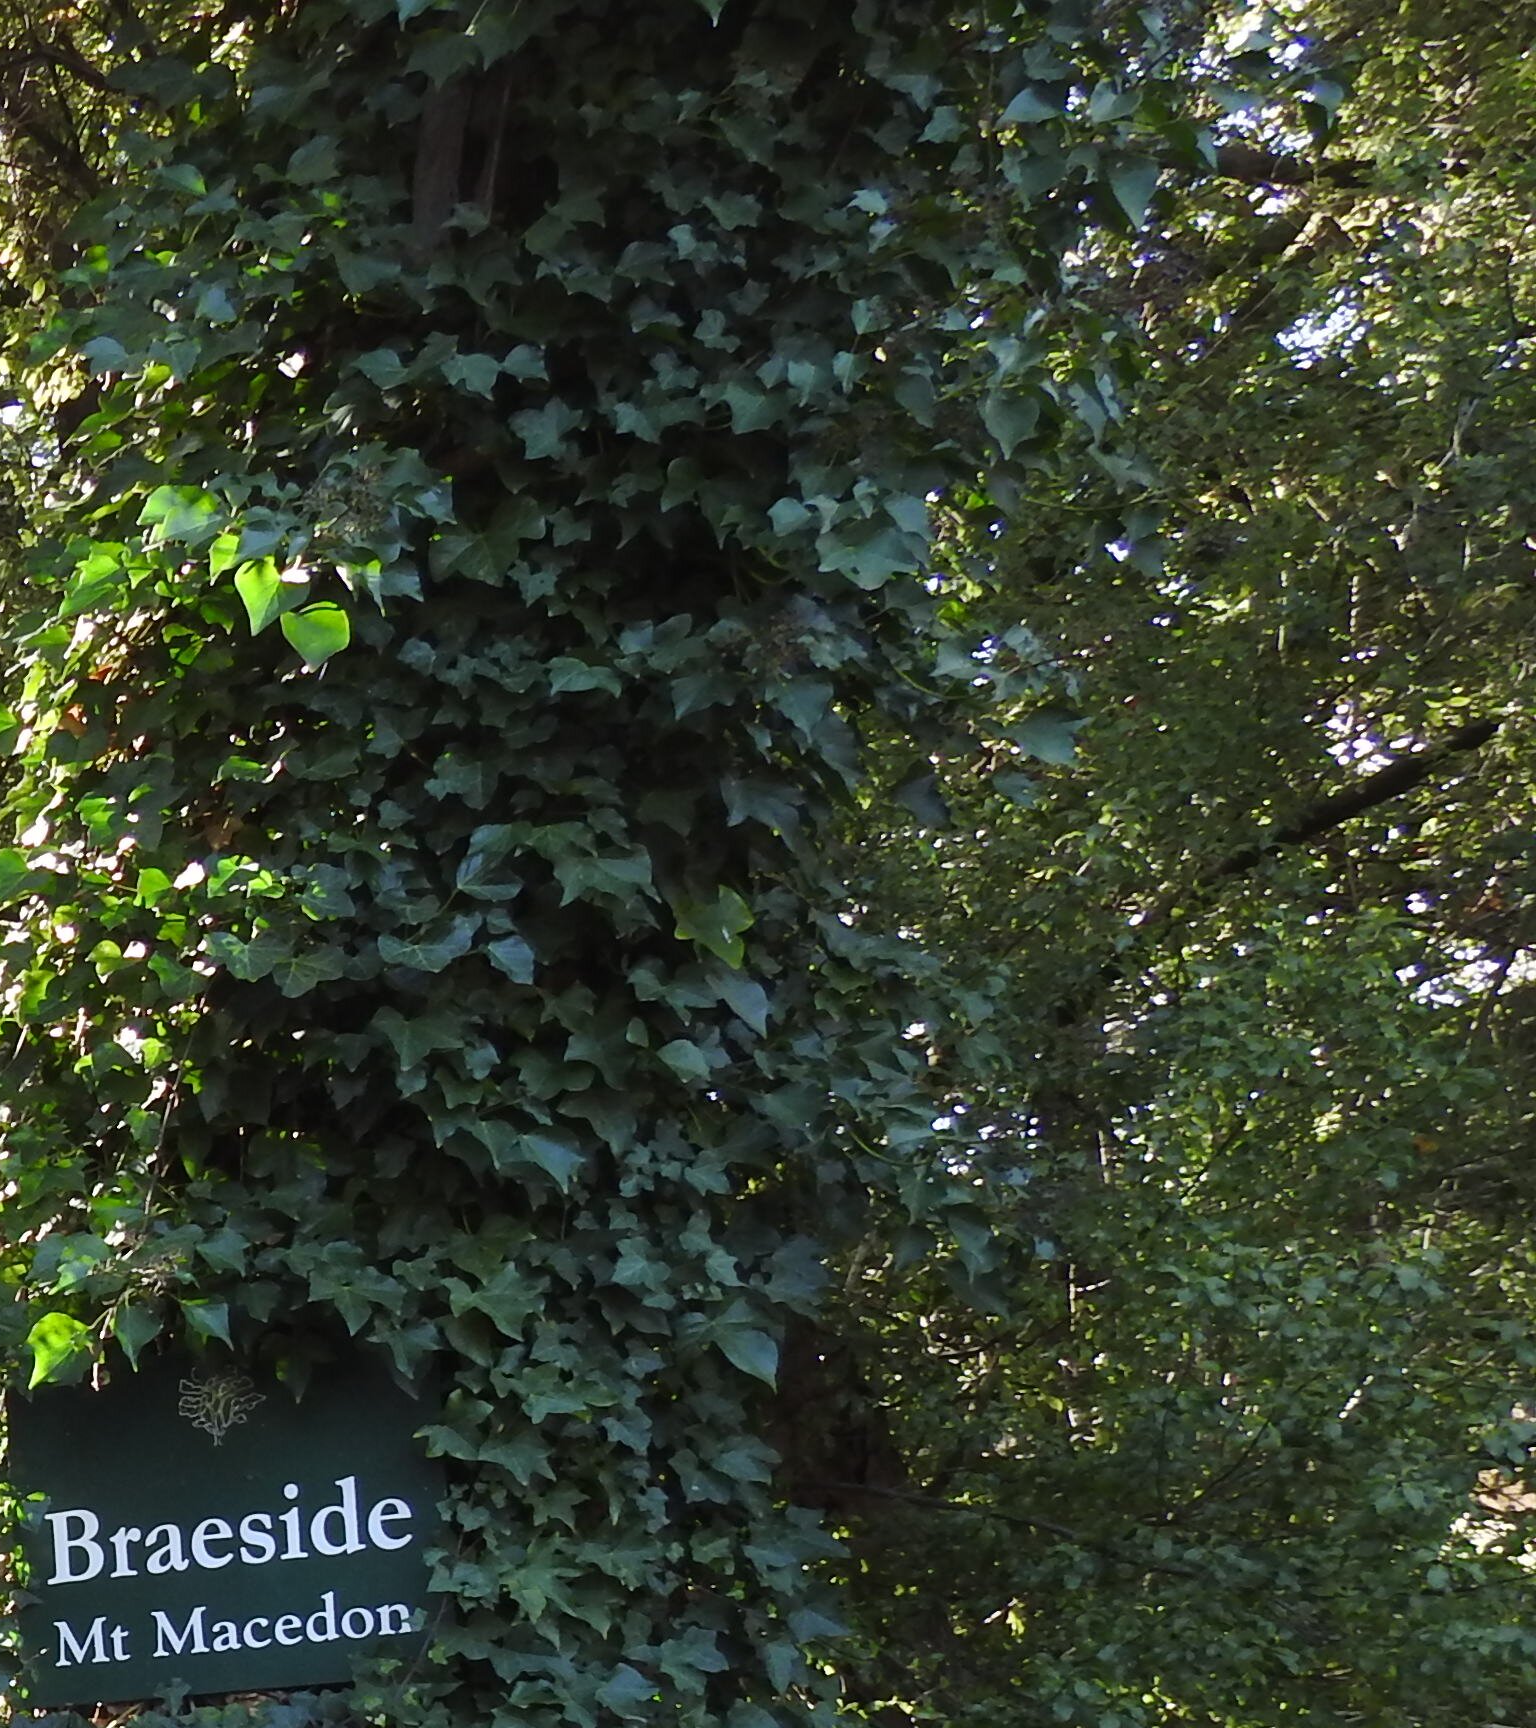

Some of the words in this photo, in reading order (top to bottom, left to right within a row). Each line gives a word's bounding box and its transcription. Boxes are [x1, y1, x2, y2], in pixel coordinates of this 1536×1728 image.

[44, 1475, 413, 1586] Braeside
[53, 1616, 131, 1667] Mt
[151, 1591, 413, 1658] Macedon
